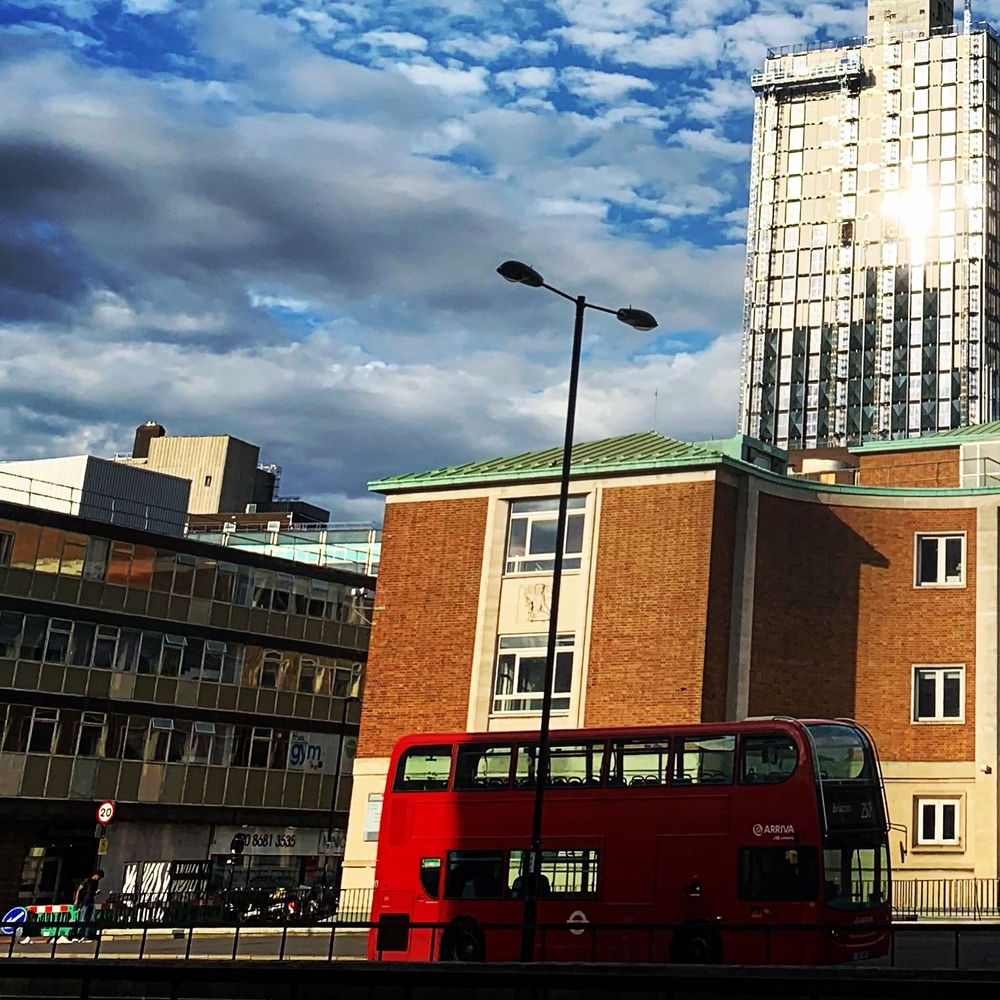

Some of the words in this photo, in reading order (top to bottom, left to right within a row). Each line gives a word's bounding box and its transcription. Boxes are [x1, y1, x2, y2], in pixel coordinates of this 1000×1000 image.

[290, 744, 321, 765] gym
[100, 807, 112, 817] 20
[763, 824, 795, 834] ARRIVA
[252, 833, 273, 847] 8681
[275, 834, 296, 848] 3535
